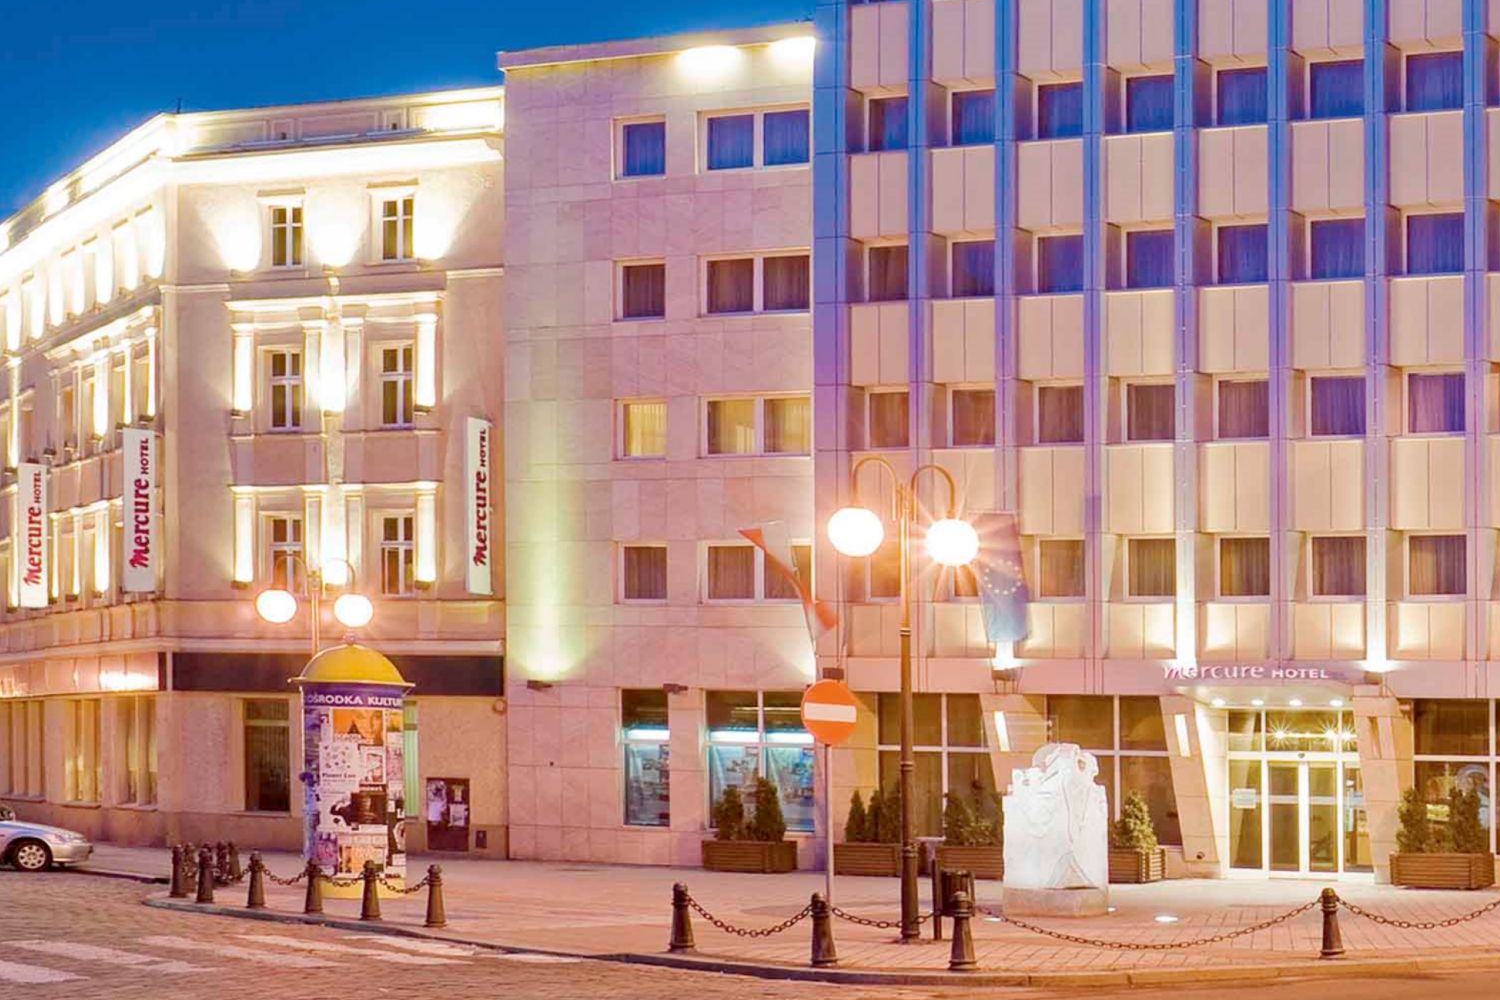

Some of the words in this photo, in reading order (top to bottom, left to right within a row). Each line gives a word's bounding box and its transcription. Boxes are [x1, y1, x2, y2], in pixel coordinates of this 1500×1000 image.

[140, 437, 150, 475] HOTEL
[479, 428, 487, 468] HOTEL
[33, 471, 42, 504] HOTEL
[1271, 668, 1329, 679] HOTEL
